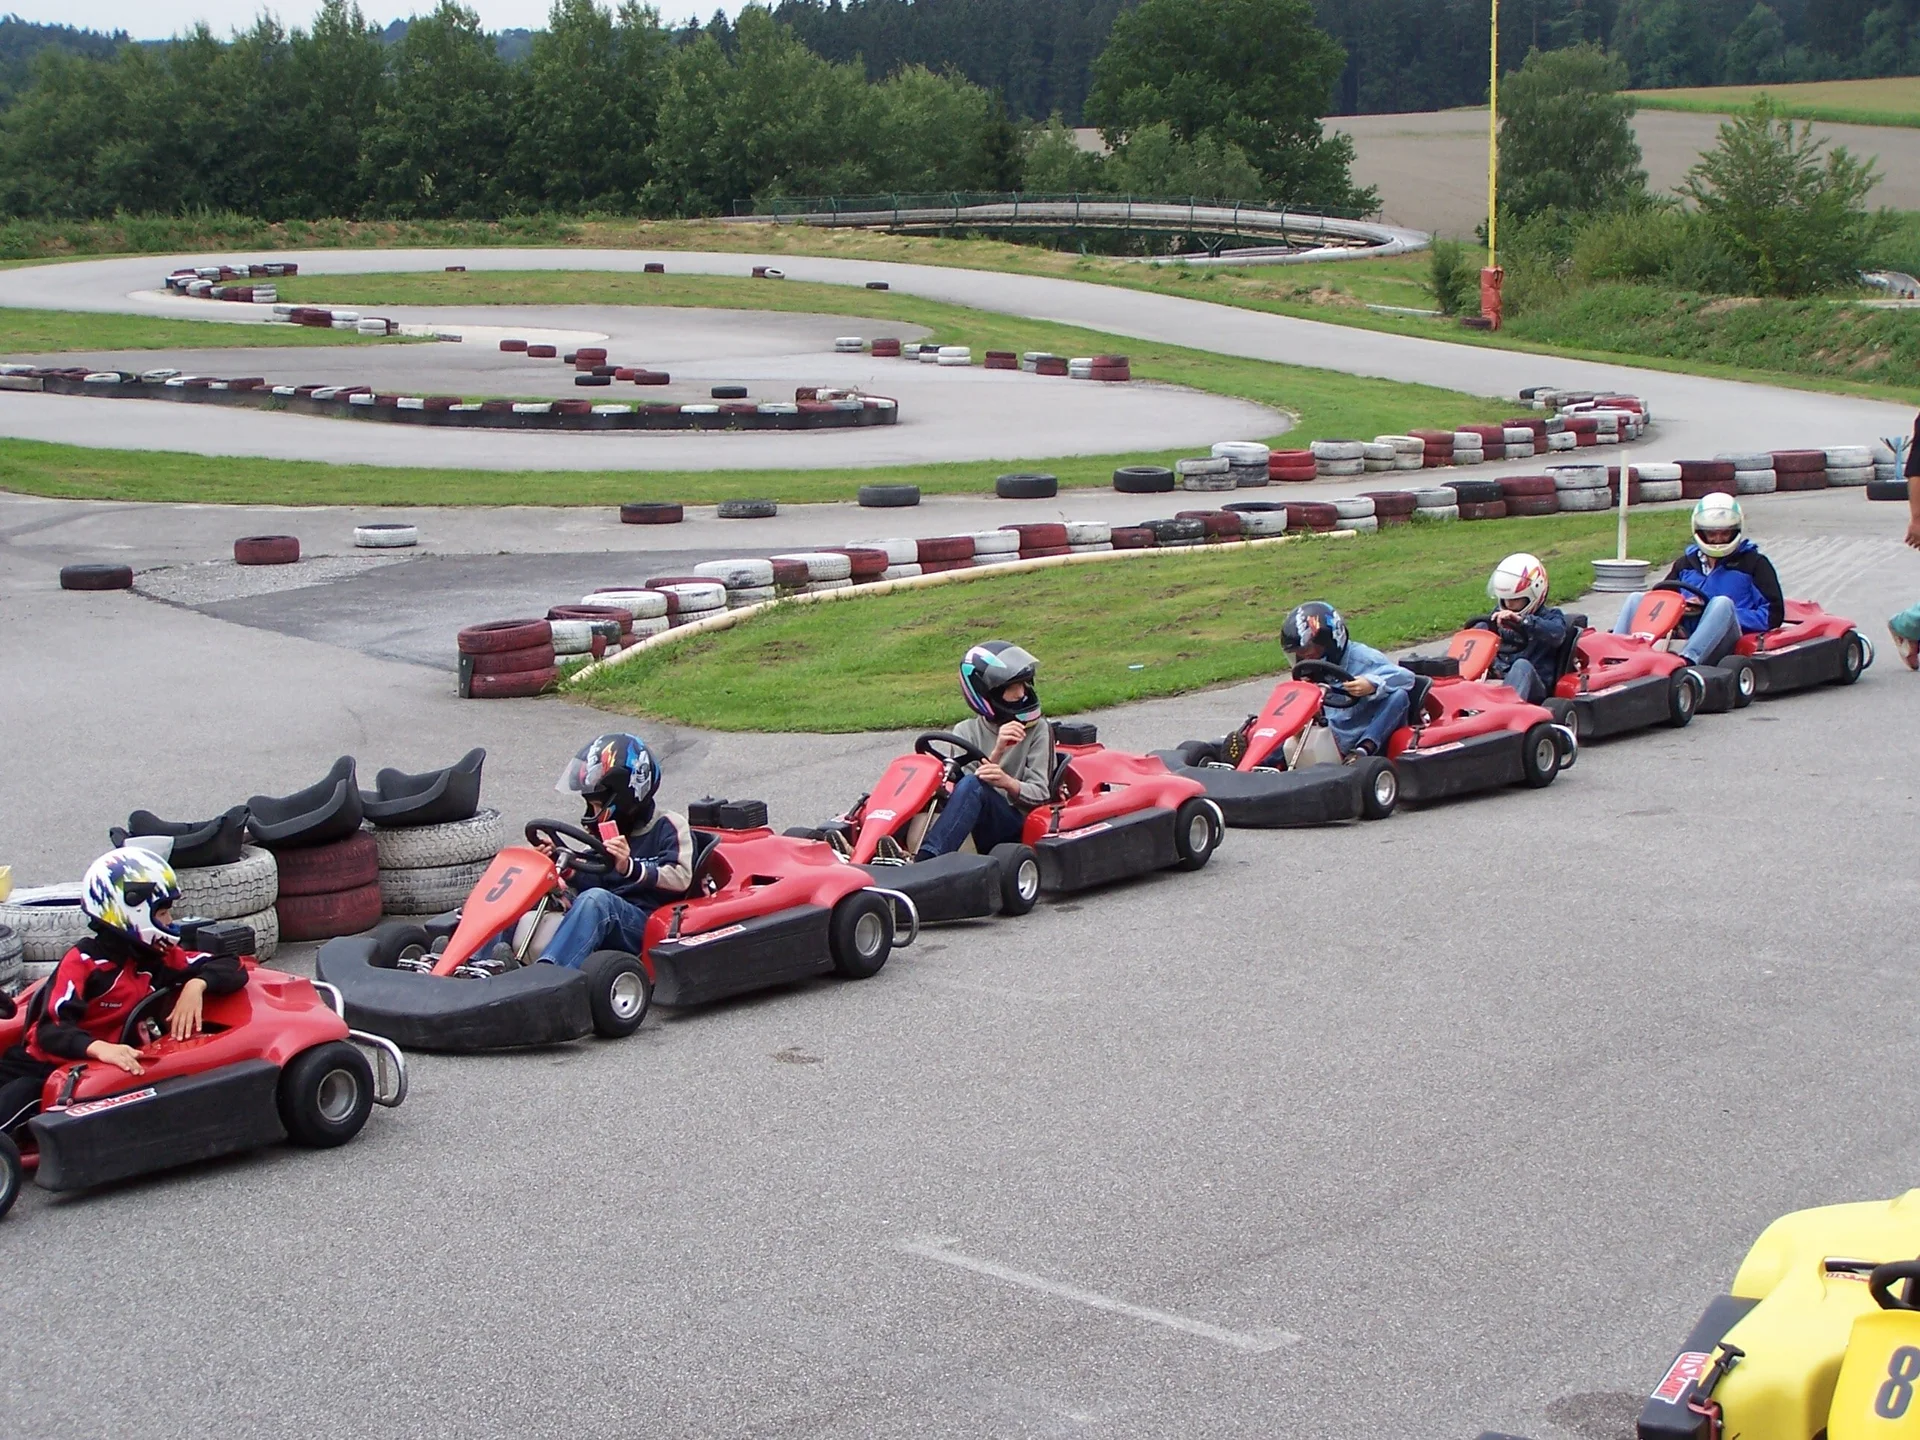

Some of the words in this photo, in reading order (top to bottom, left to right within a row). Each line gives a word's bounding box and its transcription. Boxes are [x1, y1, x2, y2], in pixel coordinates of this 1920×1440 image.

[1648, 600, 1666, 622] 4
[1459, 640, 1476, 662] 3
[1272, 690, 1300, 717] 2
[894, 766, 919, 797] 7
[484, 866, 524, 902] 5
[1874, 1345, 1920, 1419] 8
